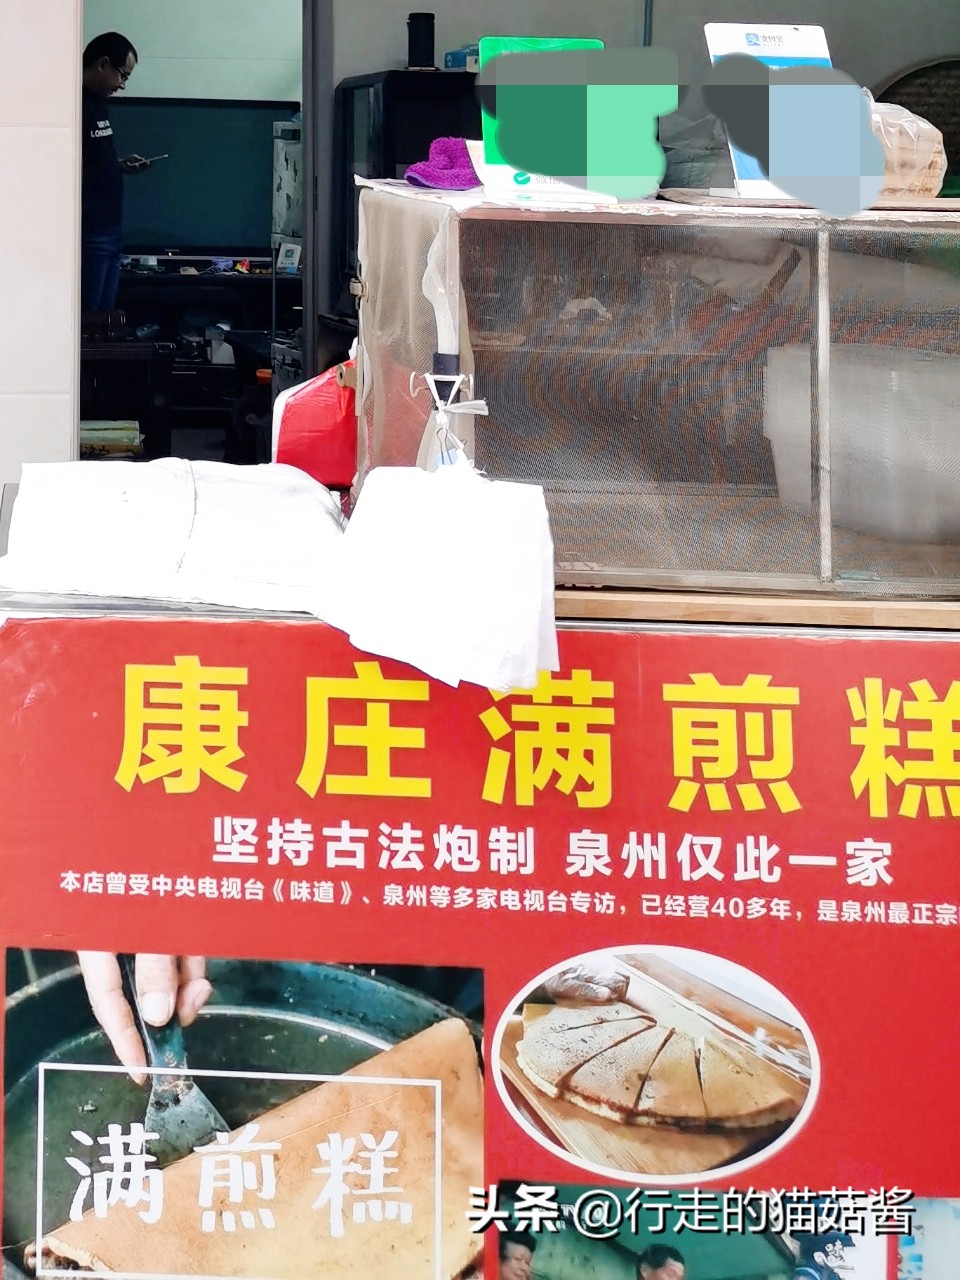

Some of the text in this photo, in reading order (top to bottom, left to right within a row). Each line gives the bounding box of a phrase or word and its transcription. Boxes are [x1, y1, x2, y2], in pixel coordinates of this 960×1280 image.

[114, 655, 960, 819] 康庄满煎糕
[59, 870, 960, 926] 本店曾受中央电视台《味道》、泉州等多家电视台专访，已经营40多年，是泉州最正宗
[212, 815, 894, 888] 坚持古法炮制 泉州仅此一家
[64, 1122, 413, 1238] 满煎糕
